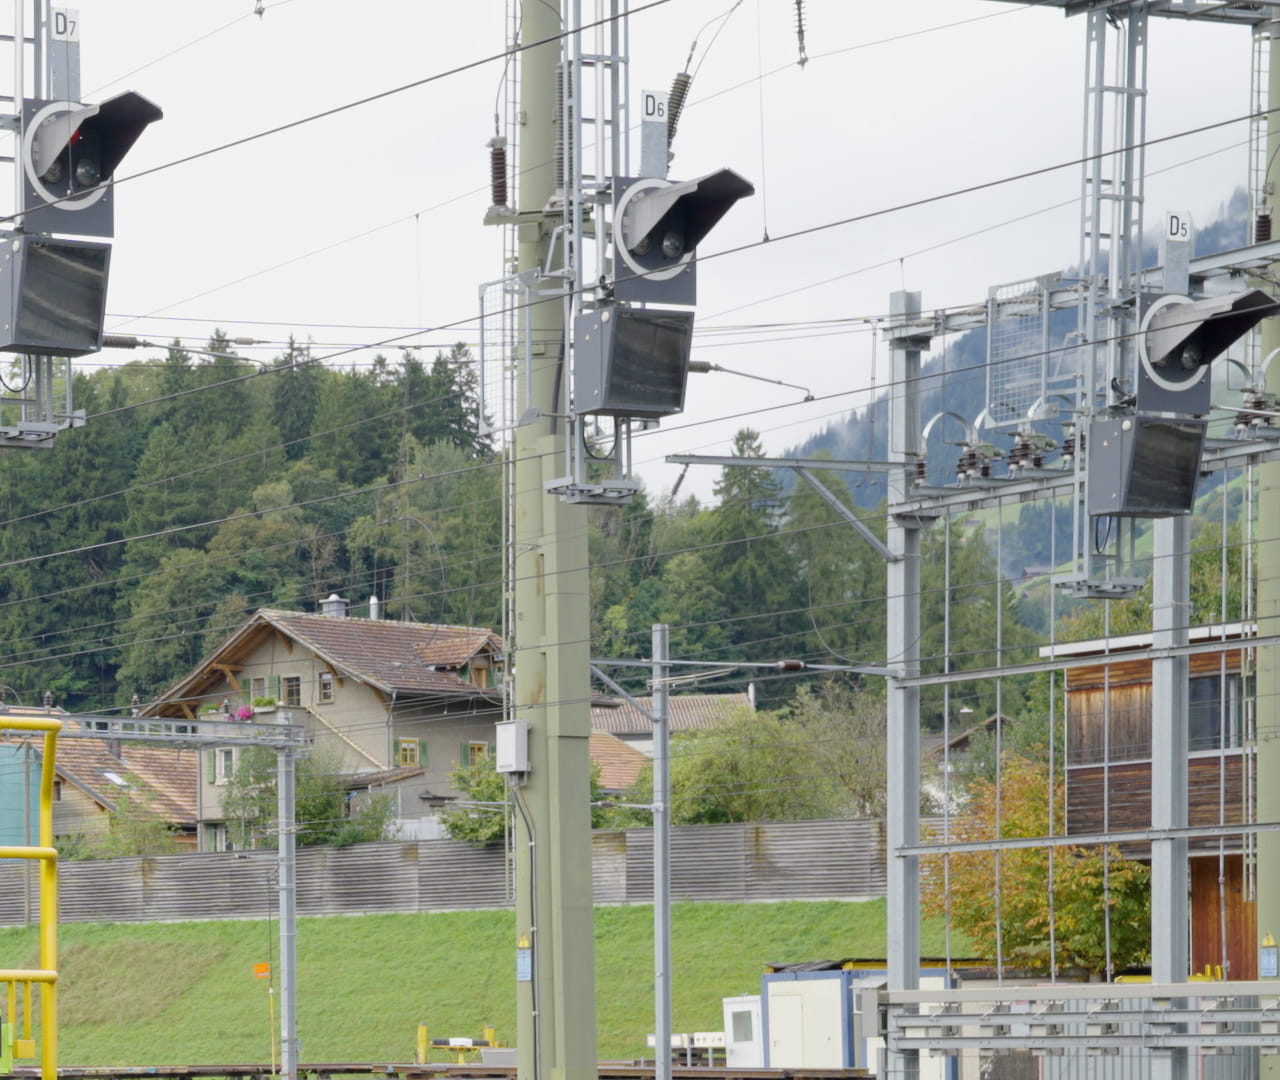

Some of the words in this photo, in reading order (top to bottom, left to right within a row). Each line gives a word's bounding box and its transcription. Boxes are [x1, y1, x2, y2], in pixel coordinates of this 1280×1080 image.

[55, 11, 77, 37] D7
[645, 93, 665, 118] D6
[1169, 214, 1188, 237] D5
